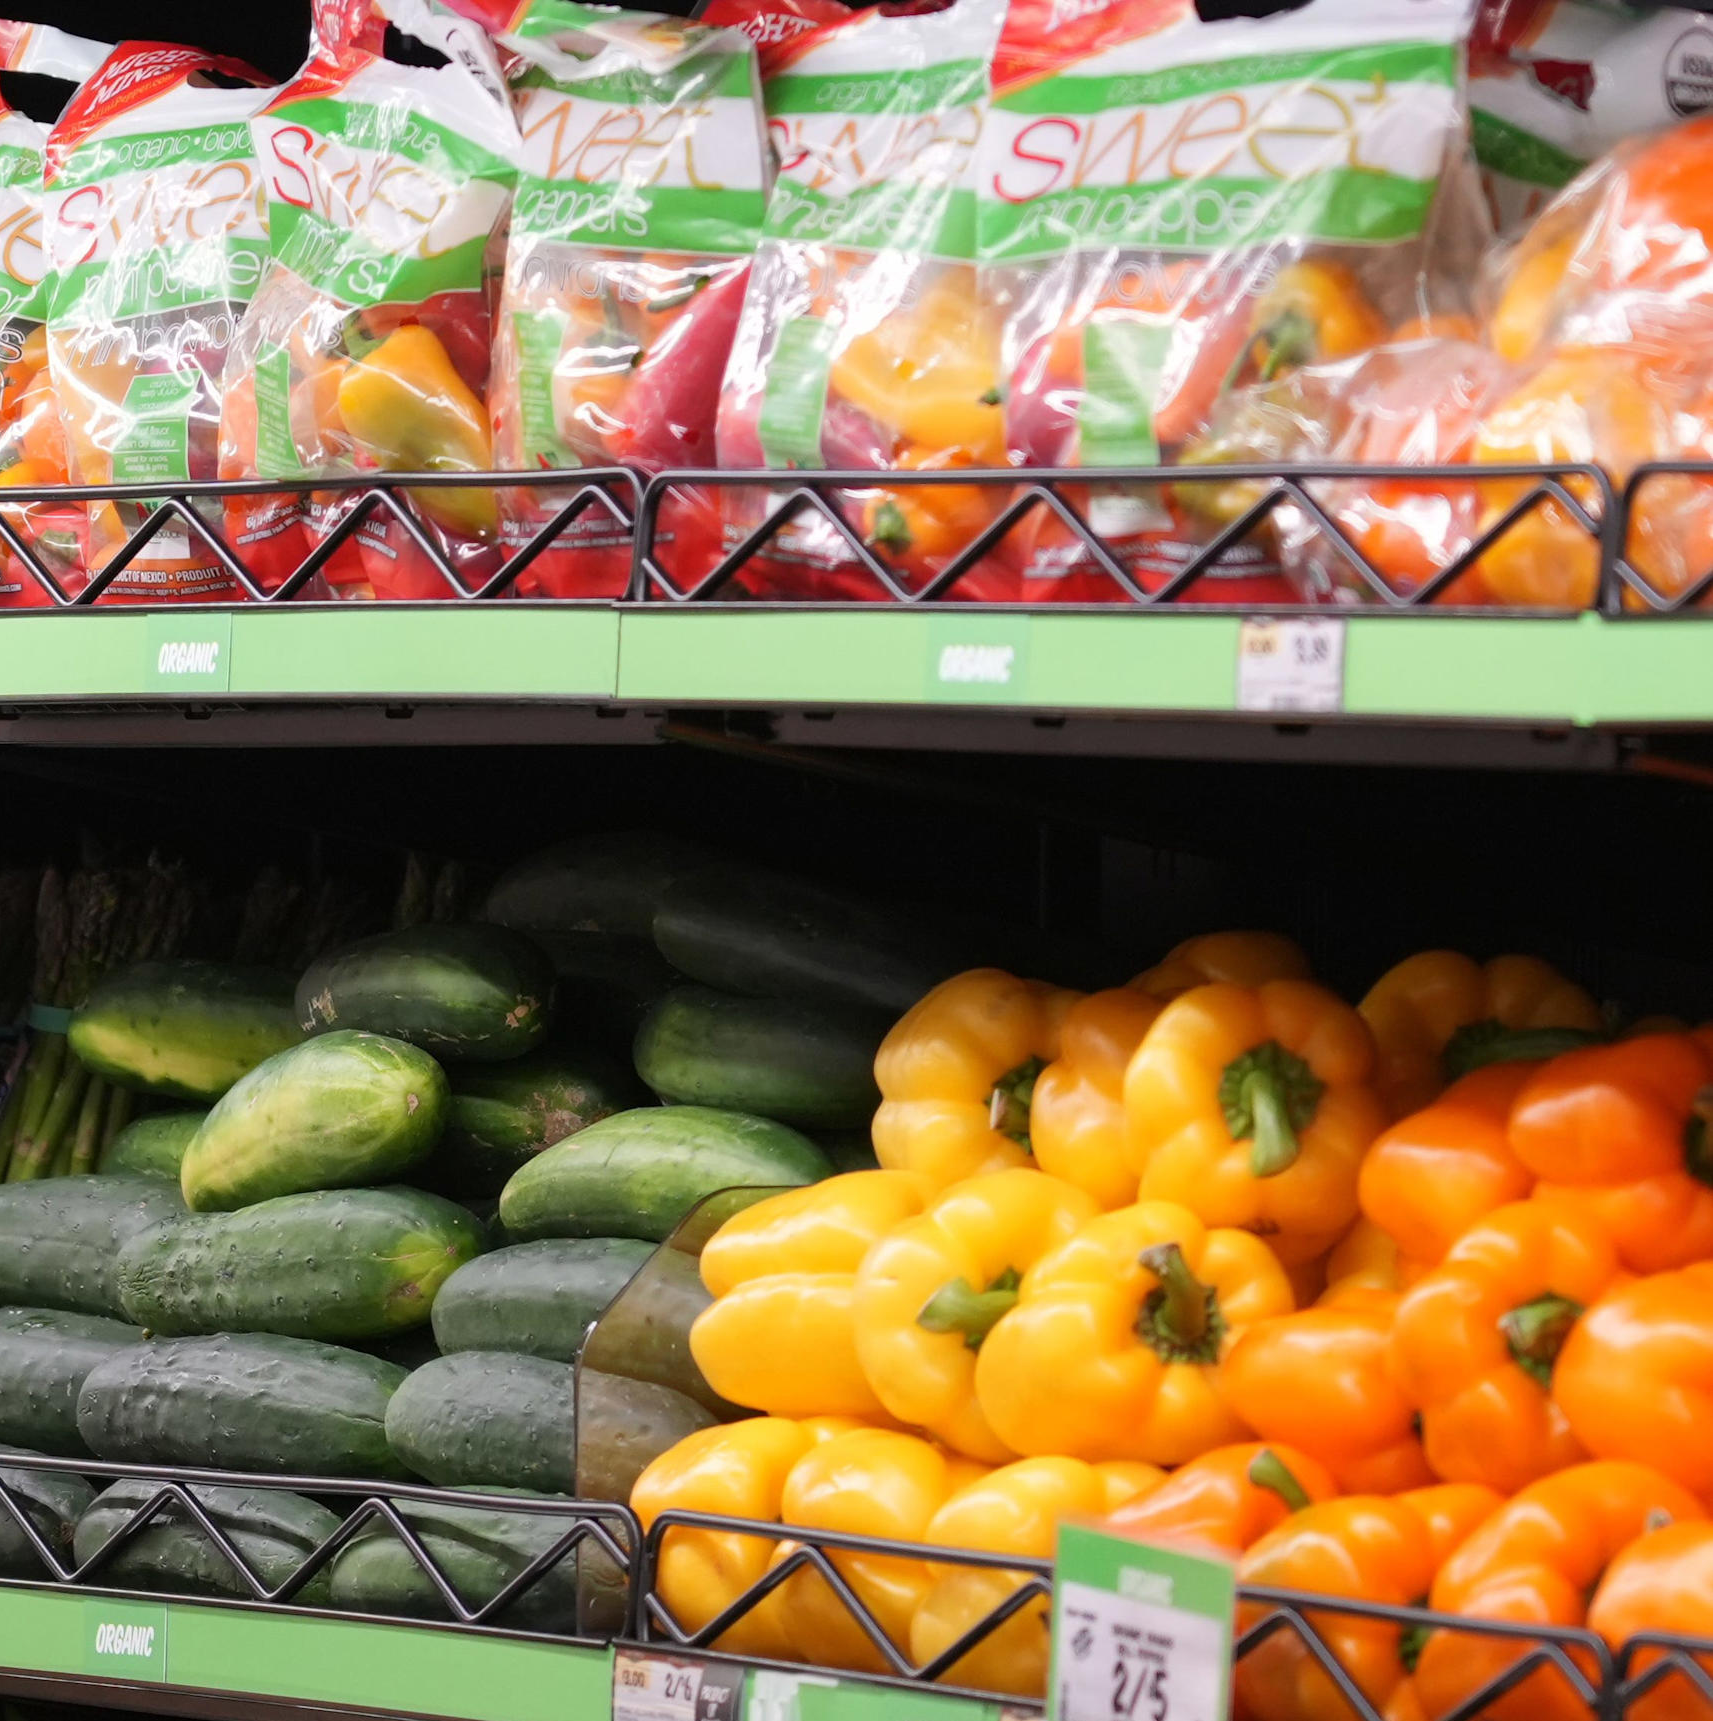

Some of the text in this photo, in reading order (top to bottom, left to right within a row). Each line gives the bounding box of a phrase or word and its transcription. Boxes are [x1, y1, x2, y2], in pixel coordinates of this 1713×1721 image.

[116, 134, 191, 168] organic
[141, 571, 167, 584] MEXICO
[175, 567, 221, 582] PRODUIT
[158, 641, 218, 674] ORGANIC
[96, 1622, 155, 1657] ORGANIC
